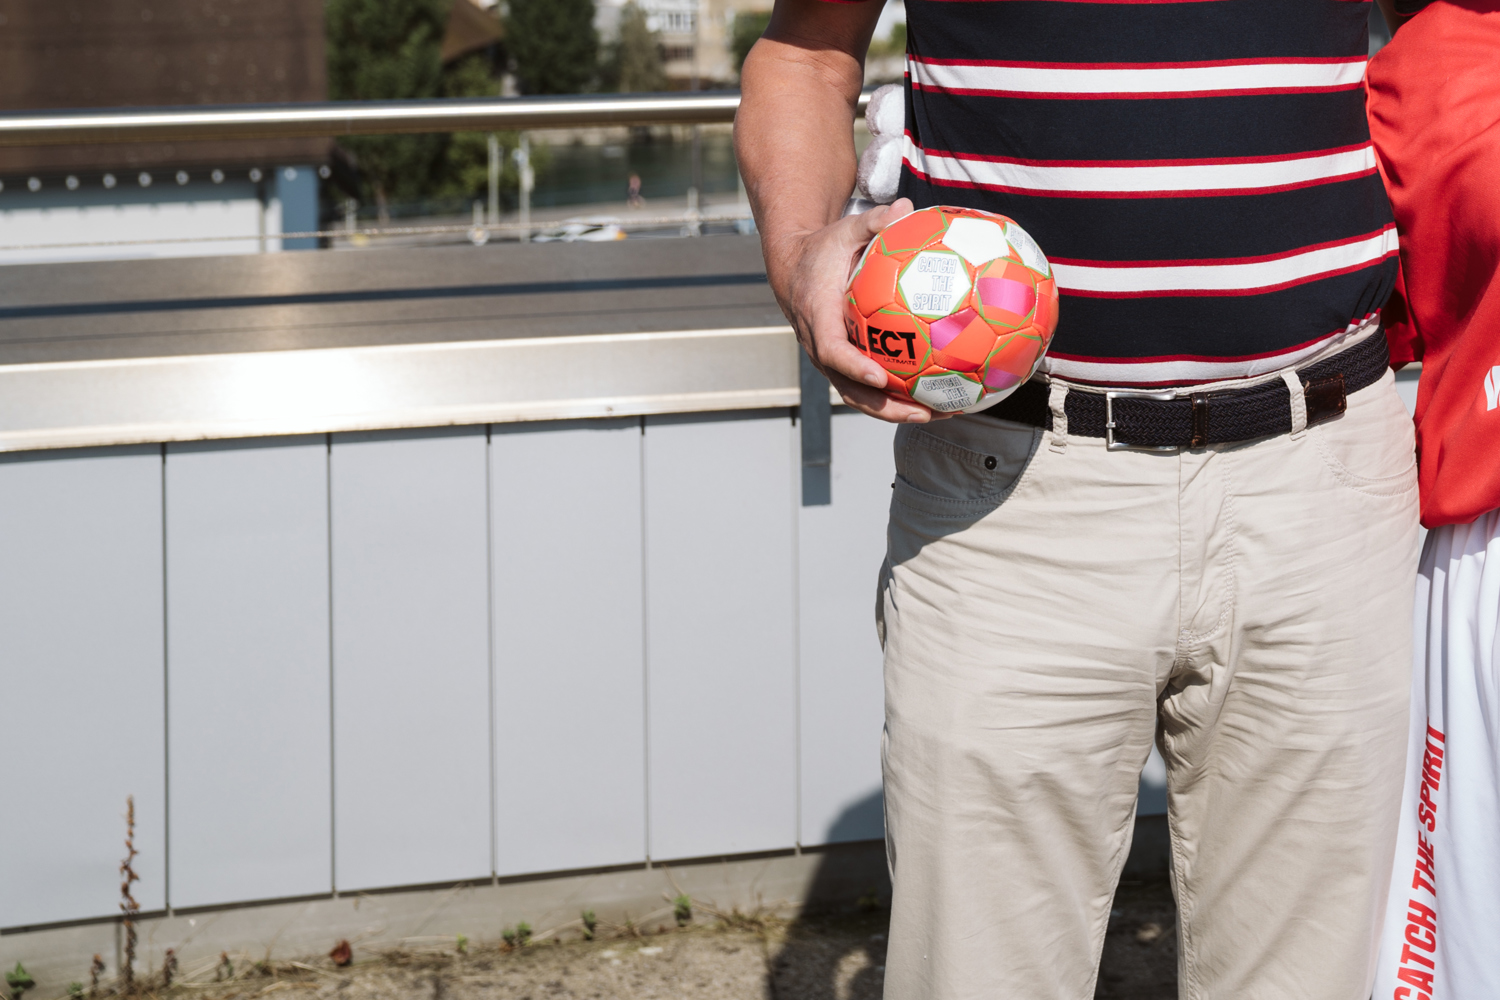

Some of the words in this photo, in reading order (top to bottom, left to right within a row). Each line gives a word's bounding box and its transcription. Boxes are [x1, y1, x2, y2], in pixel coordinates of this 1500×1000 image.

[917, 256, 958, 274] CATCH
[931, 275, 955, 292] THE
[913, 293, 953, 311] SPIRIT
[846, 316, 917, 360] ELECT
[884, 357, 917, 366] ULTIMATE
[921, 377, 963, 391] CATCH
[942, 387, 968, 400] THE
[1418, 716, 1446, 833] SPIRIT
[1412, 830, 1437, 898] THE
